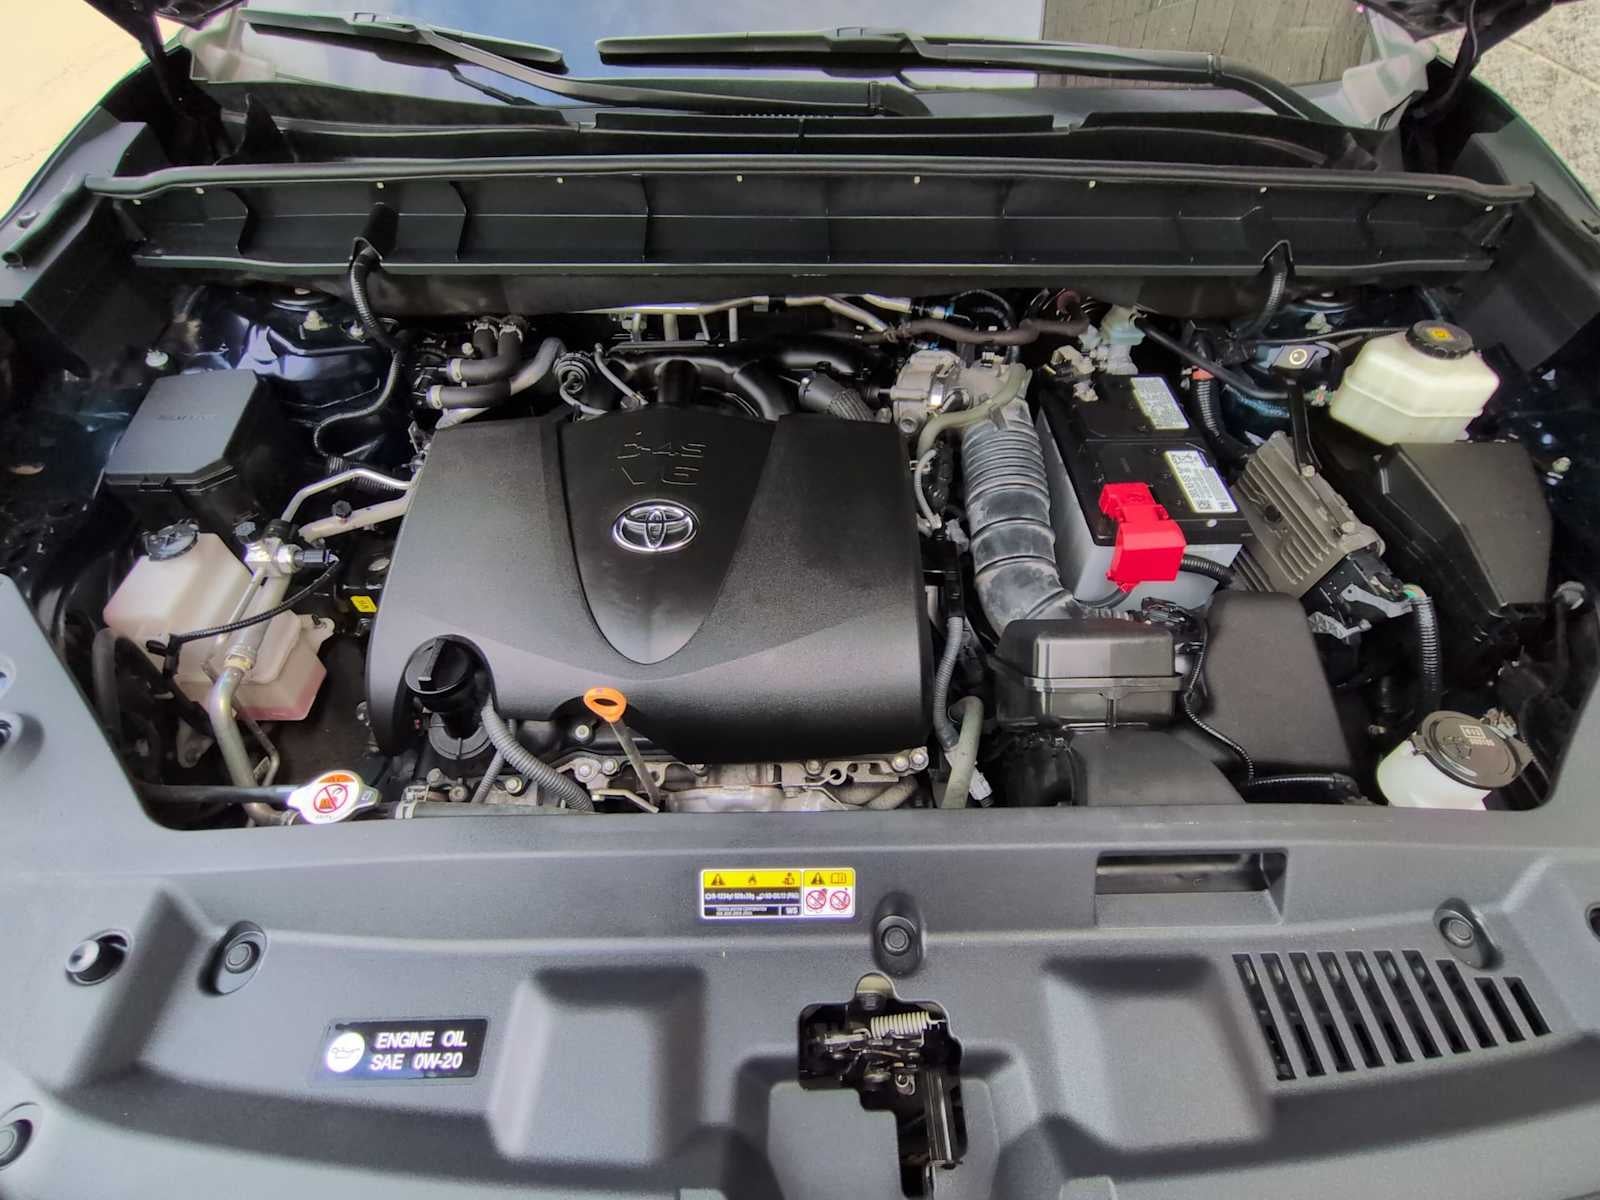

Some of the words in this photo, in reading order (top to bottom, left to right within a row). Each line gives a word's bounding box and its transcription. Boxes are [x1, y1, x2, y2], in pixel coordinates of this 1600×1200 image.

[375, 1031, 435, 1049] ENGINE
[440, 1030, 468, 1048] OIL
[370, 1053, 405, 1071] SAE
[412, 1052, 463, 1070] 0W-20
